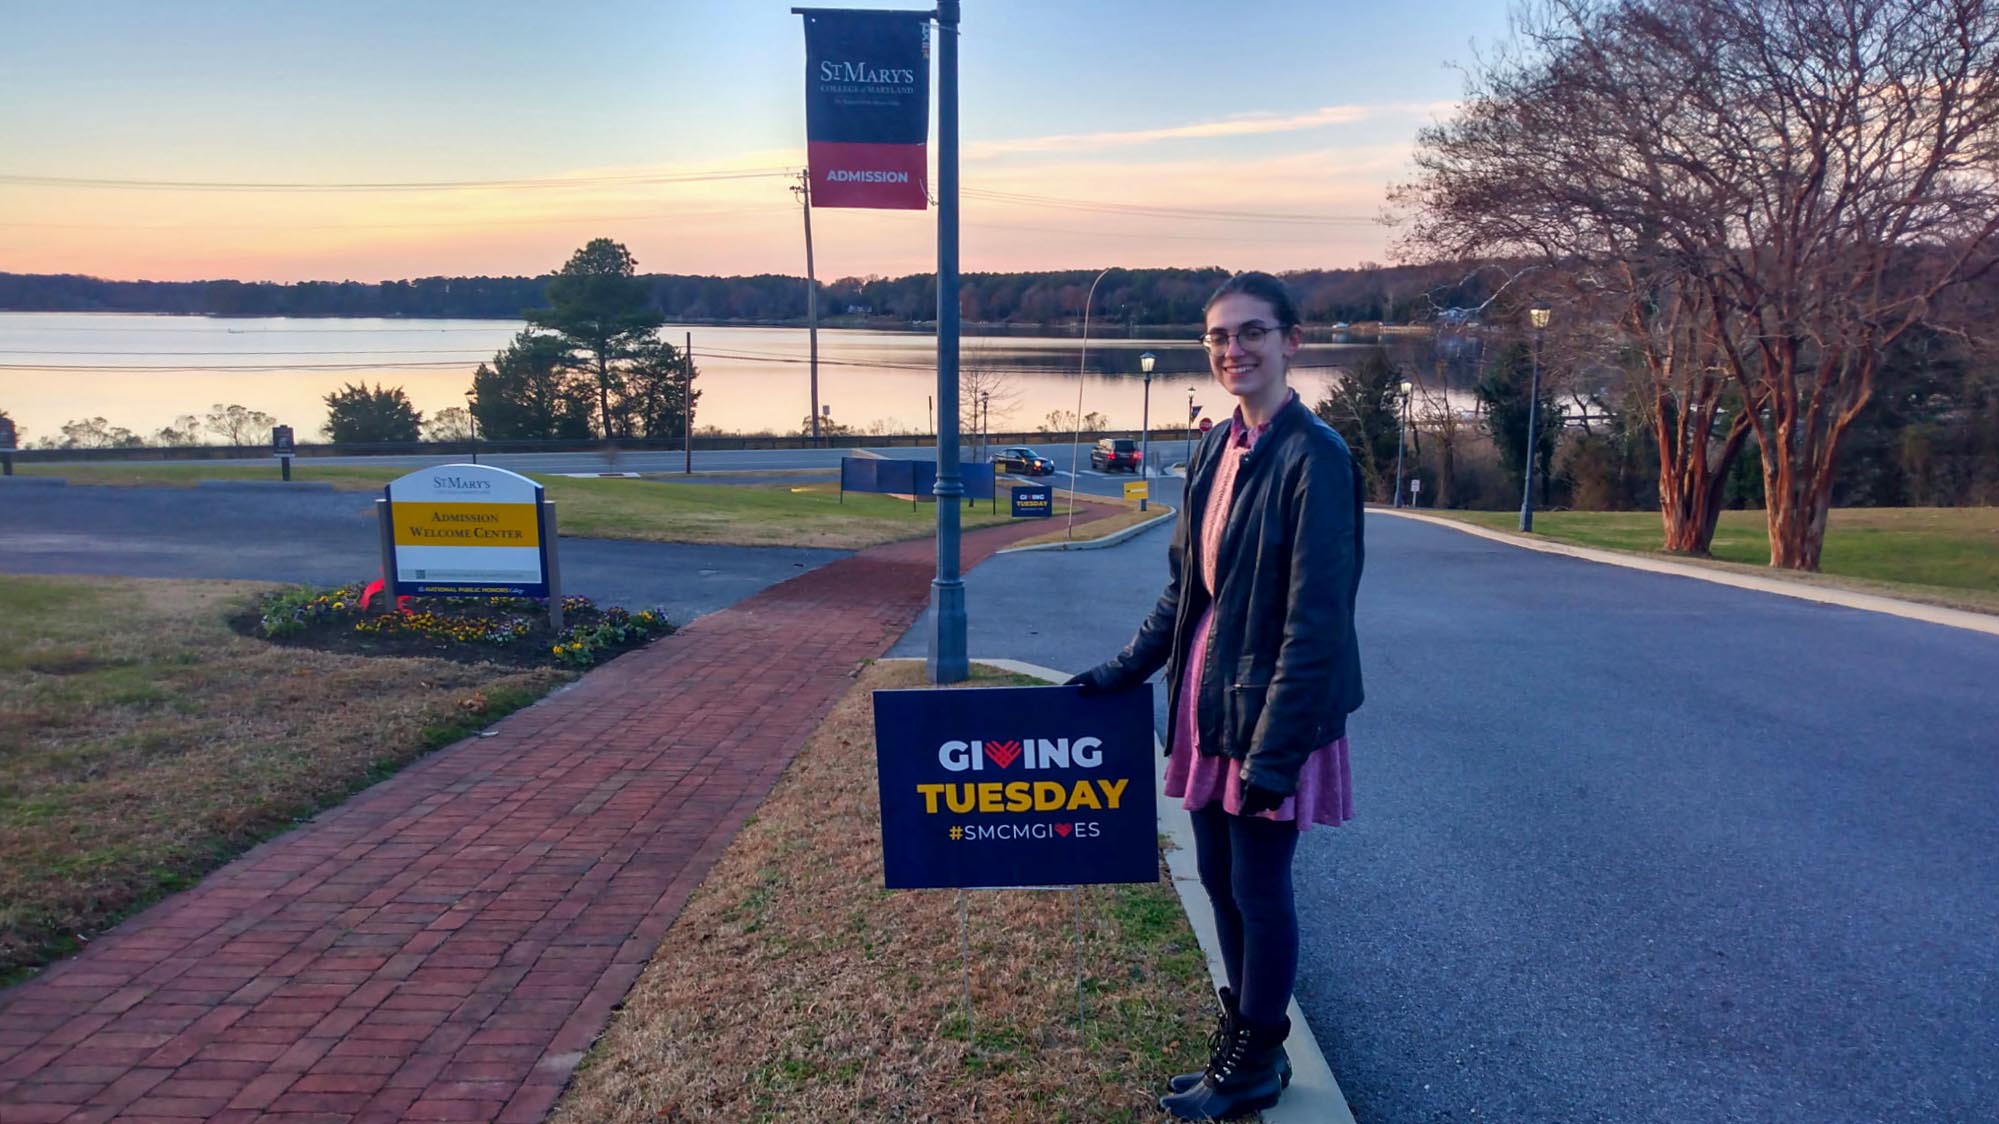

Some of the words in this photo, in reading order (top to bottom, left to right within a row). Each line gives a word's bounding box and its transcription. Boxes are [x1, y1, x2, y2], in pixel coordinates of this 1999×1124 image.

[844, 62, 914, 83] MARY'S
[827, 170, 908, 183] ADMISSION
[431, 512, 498, 523] ADMISSION
[409, 527, 470, 537] WELCOME
[474, 527, 522, 538] CENTER
[916, 778, 1129, 814] TUESDAY
